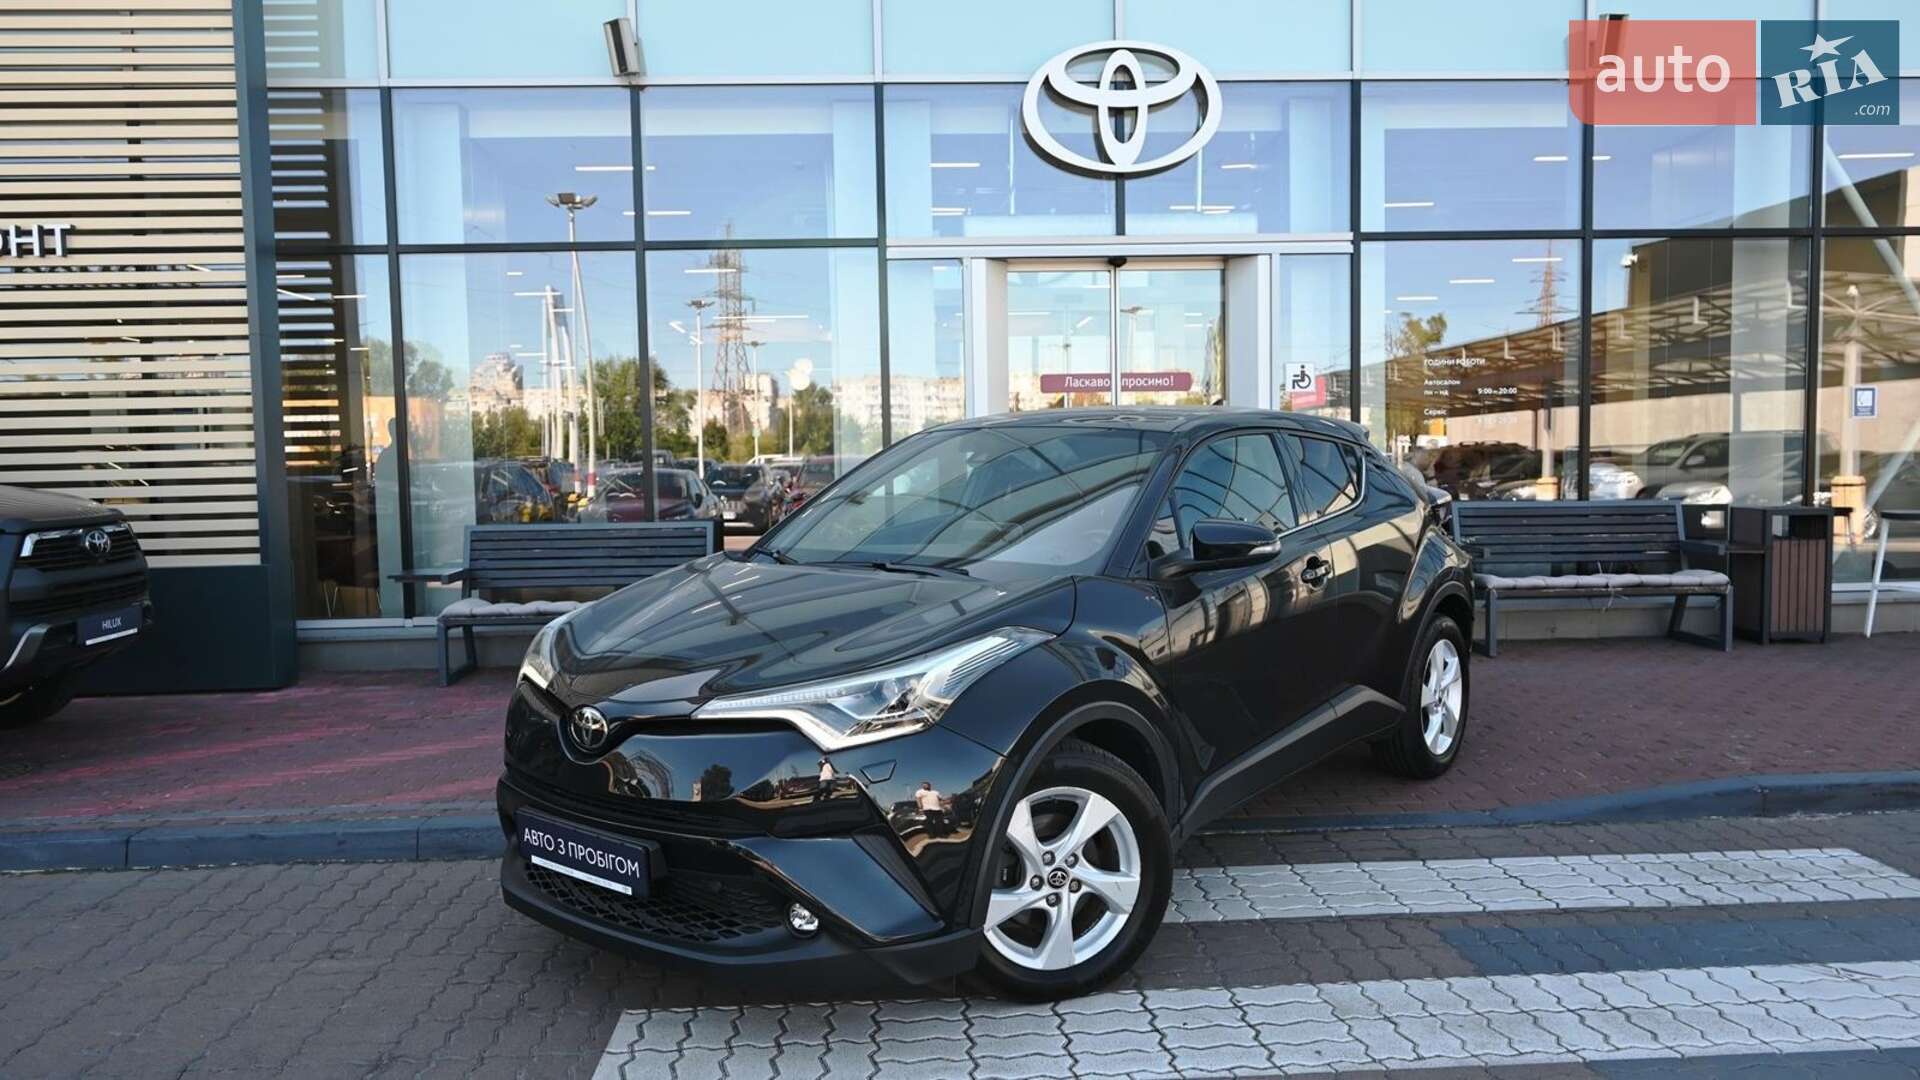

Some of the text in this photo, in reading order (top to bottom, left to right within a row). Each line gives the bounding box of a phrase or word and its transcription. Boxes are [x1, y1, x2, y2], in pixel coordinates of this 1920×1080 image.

[0, 224, 72, 257] НТ
[1424, 359, 1486, 367] ГОДИНИ РОБОТИ
[1064, 375, 1175, 389] Ласкаво просимо!
[1423, 408, 1448, 416] Сервіс
[102, 617, 122, 631] HILUX
[523, 827, 555, 851] АВТО
[557, 838, 566, 855] З
[568, 841, 640, 878] ПРОБІГОМ
